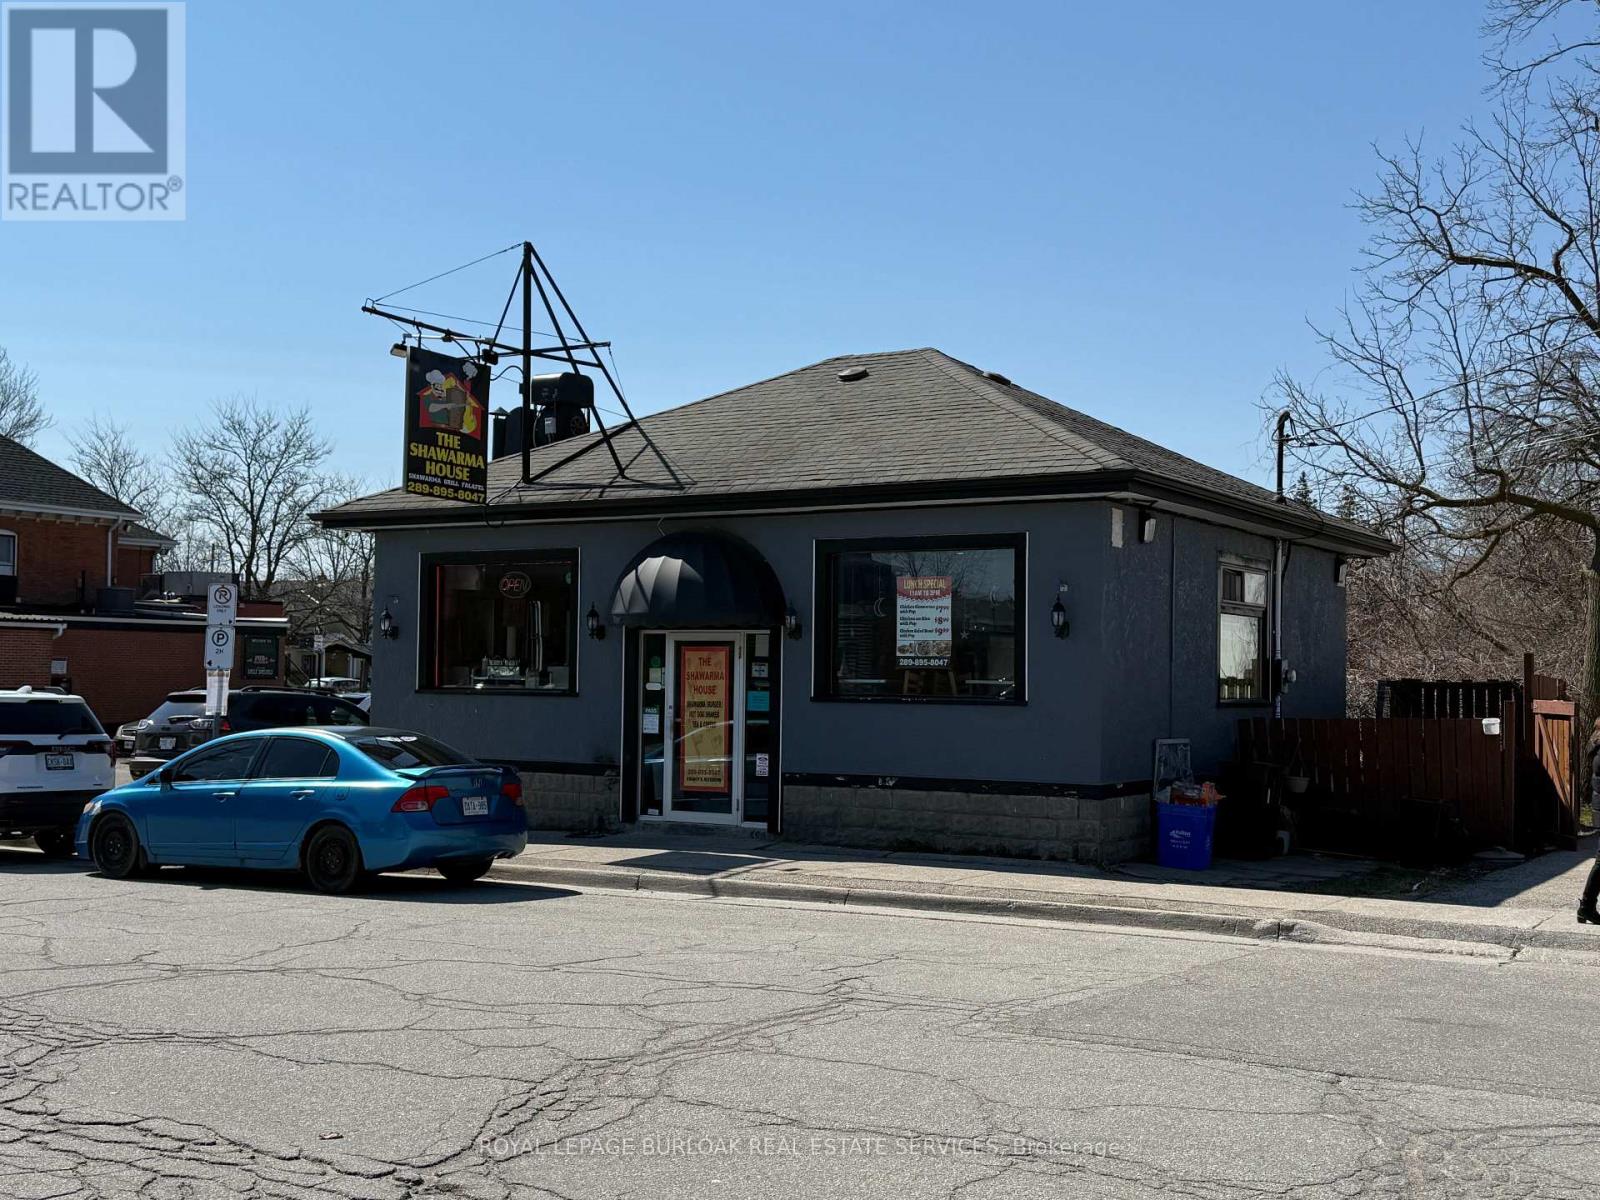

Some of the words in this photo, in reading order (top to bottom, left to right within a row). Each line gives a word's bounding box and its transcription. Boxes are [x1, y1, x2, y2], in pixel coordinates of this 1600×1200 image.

[436, 432, 460, 449] THE
[409, 442, 485, 469] SHAWARMA
[425, 461, 470, 481] HOUSE
[904, 579, 923, 589] LUNCH
[924, 579, 946, 589] SPECIAL
[698, 656, 712, 666] THE
[686, 671, 724, 680] SHAWARMA
[693, 685, 717, 695] HOUSE
